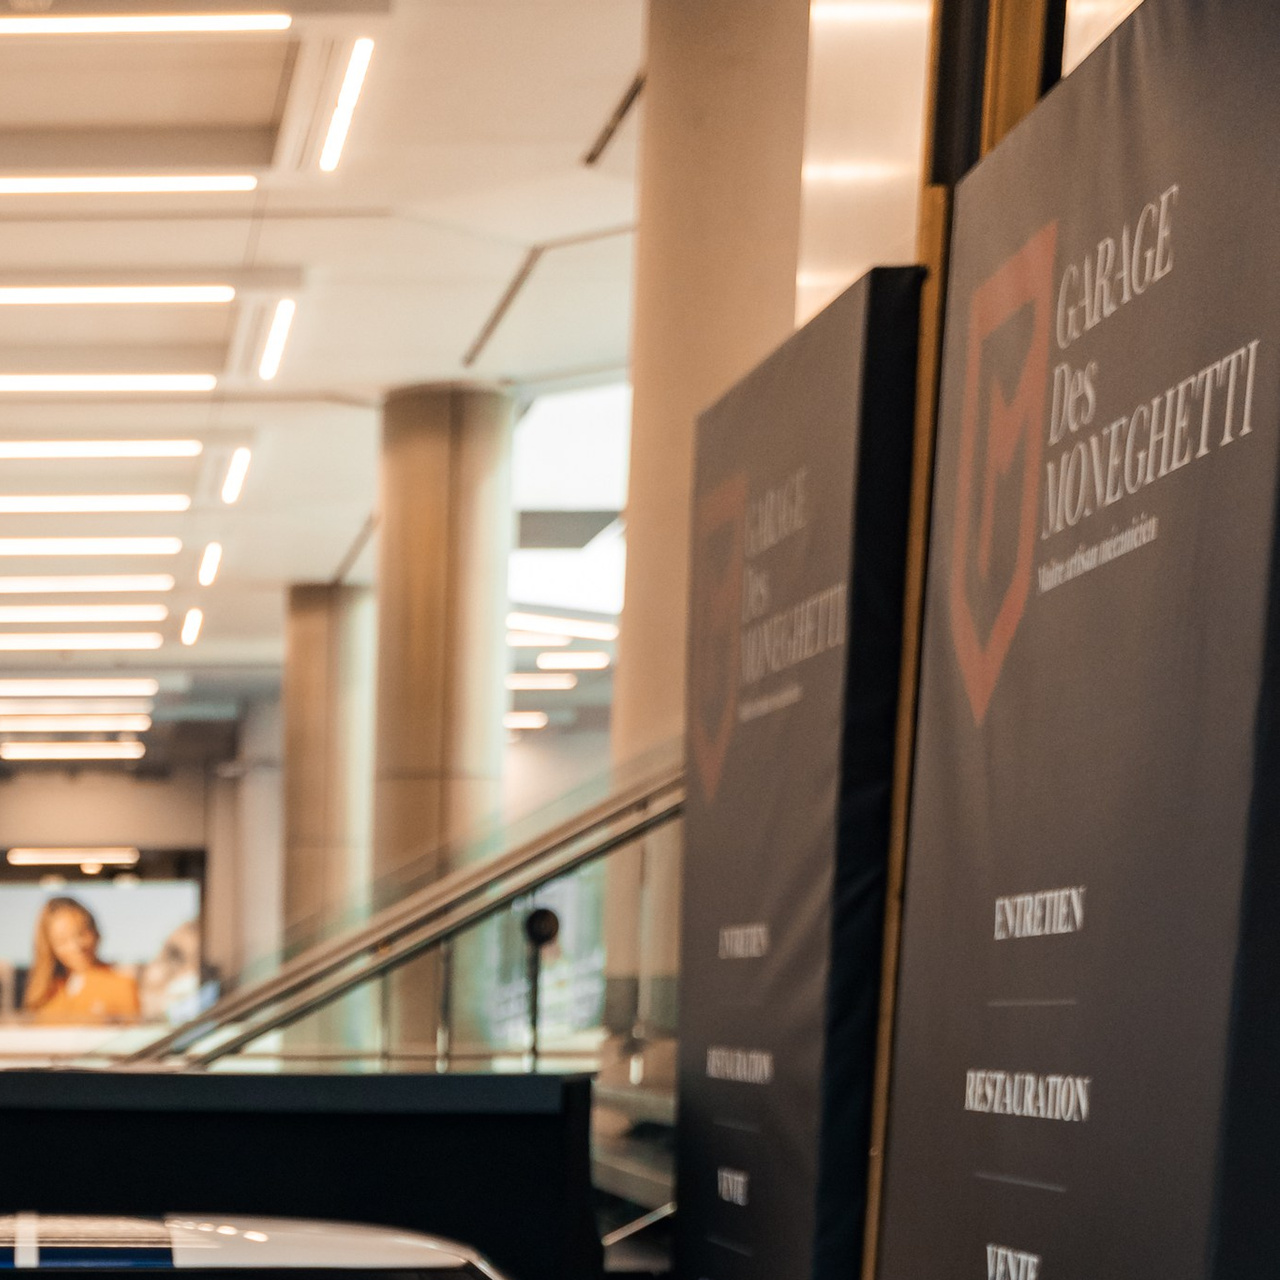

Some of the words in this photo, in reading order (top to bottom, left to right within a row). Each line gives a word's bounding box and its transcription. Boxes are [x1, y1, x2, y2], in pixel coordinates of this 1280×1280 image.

[1057, 184, 1179, 350] GARAGE
[1040, 338, 1260, 541] MONEGHETTI
[1048, 360, 1098, 446] Des
[993, 884, 1087, 941] ENTRETIEN
[965, 1069, 1091, 1122] RESTAURATION
